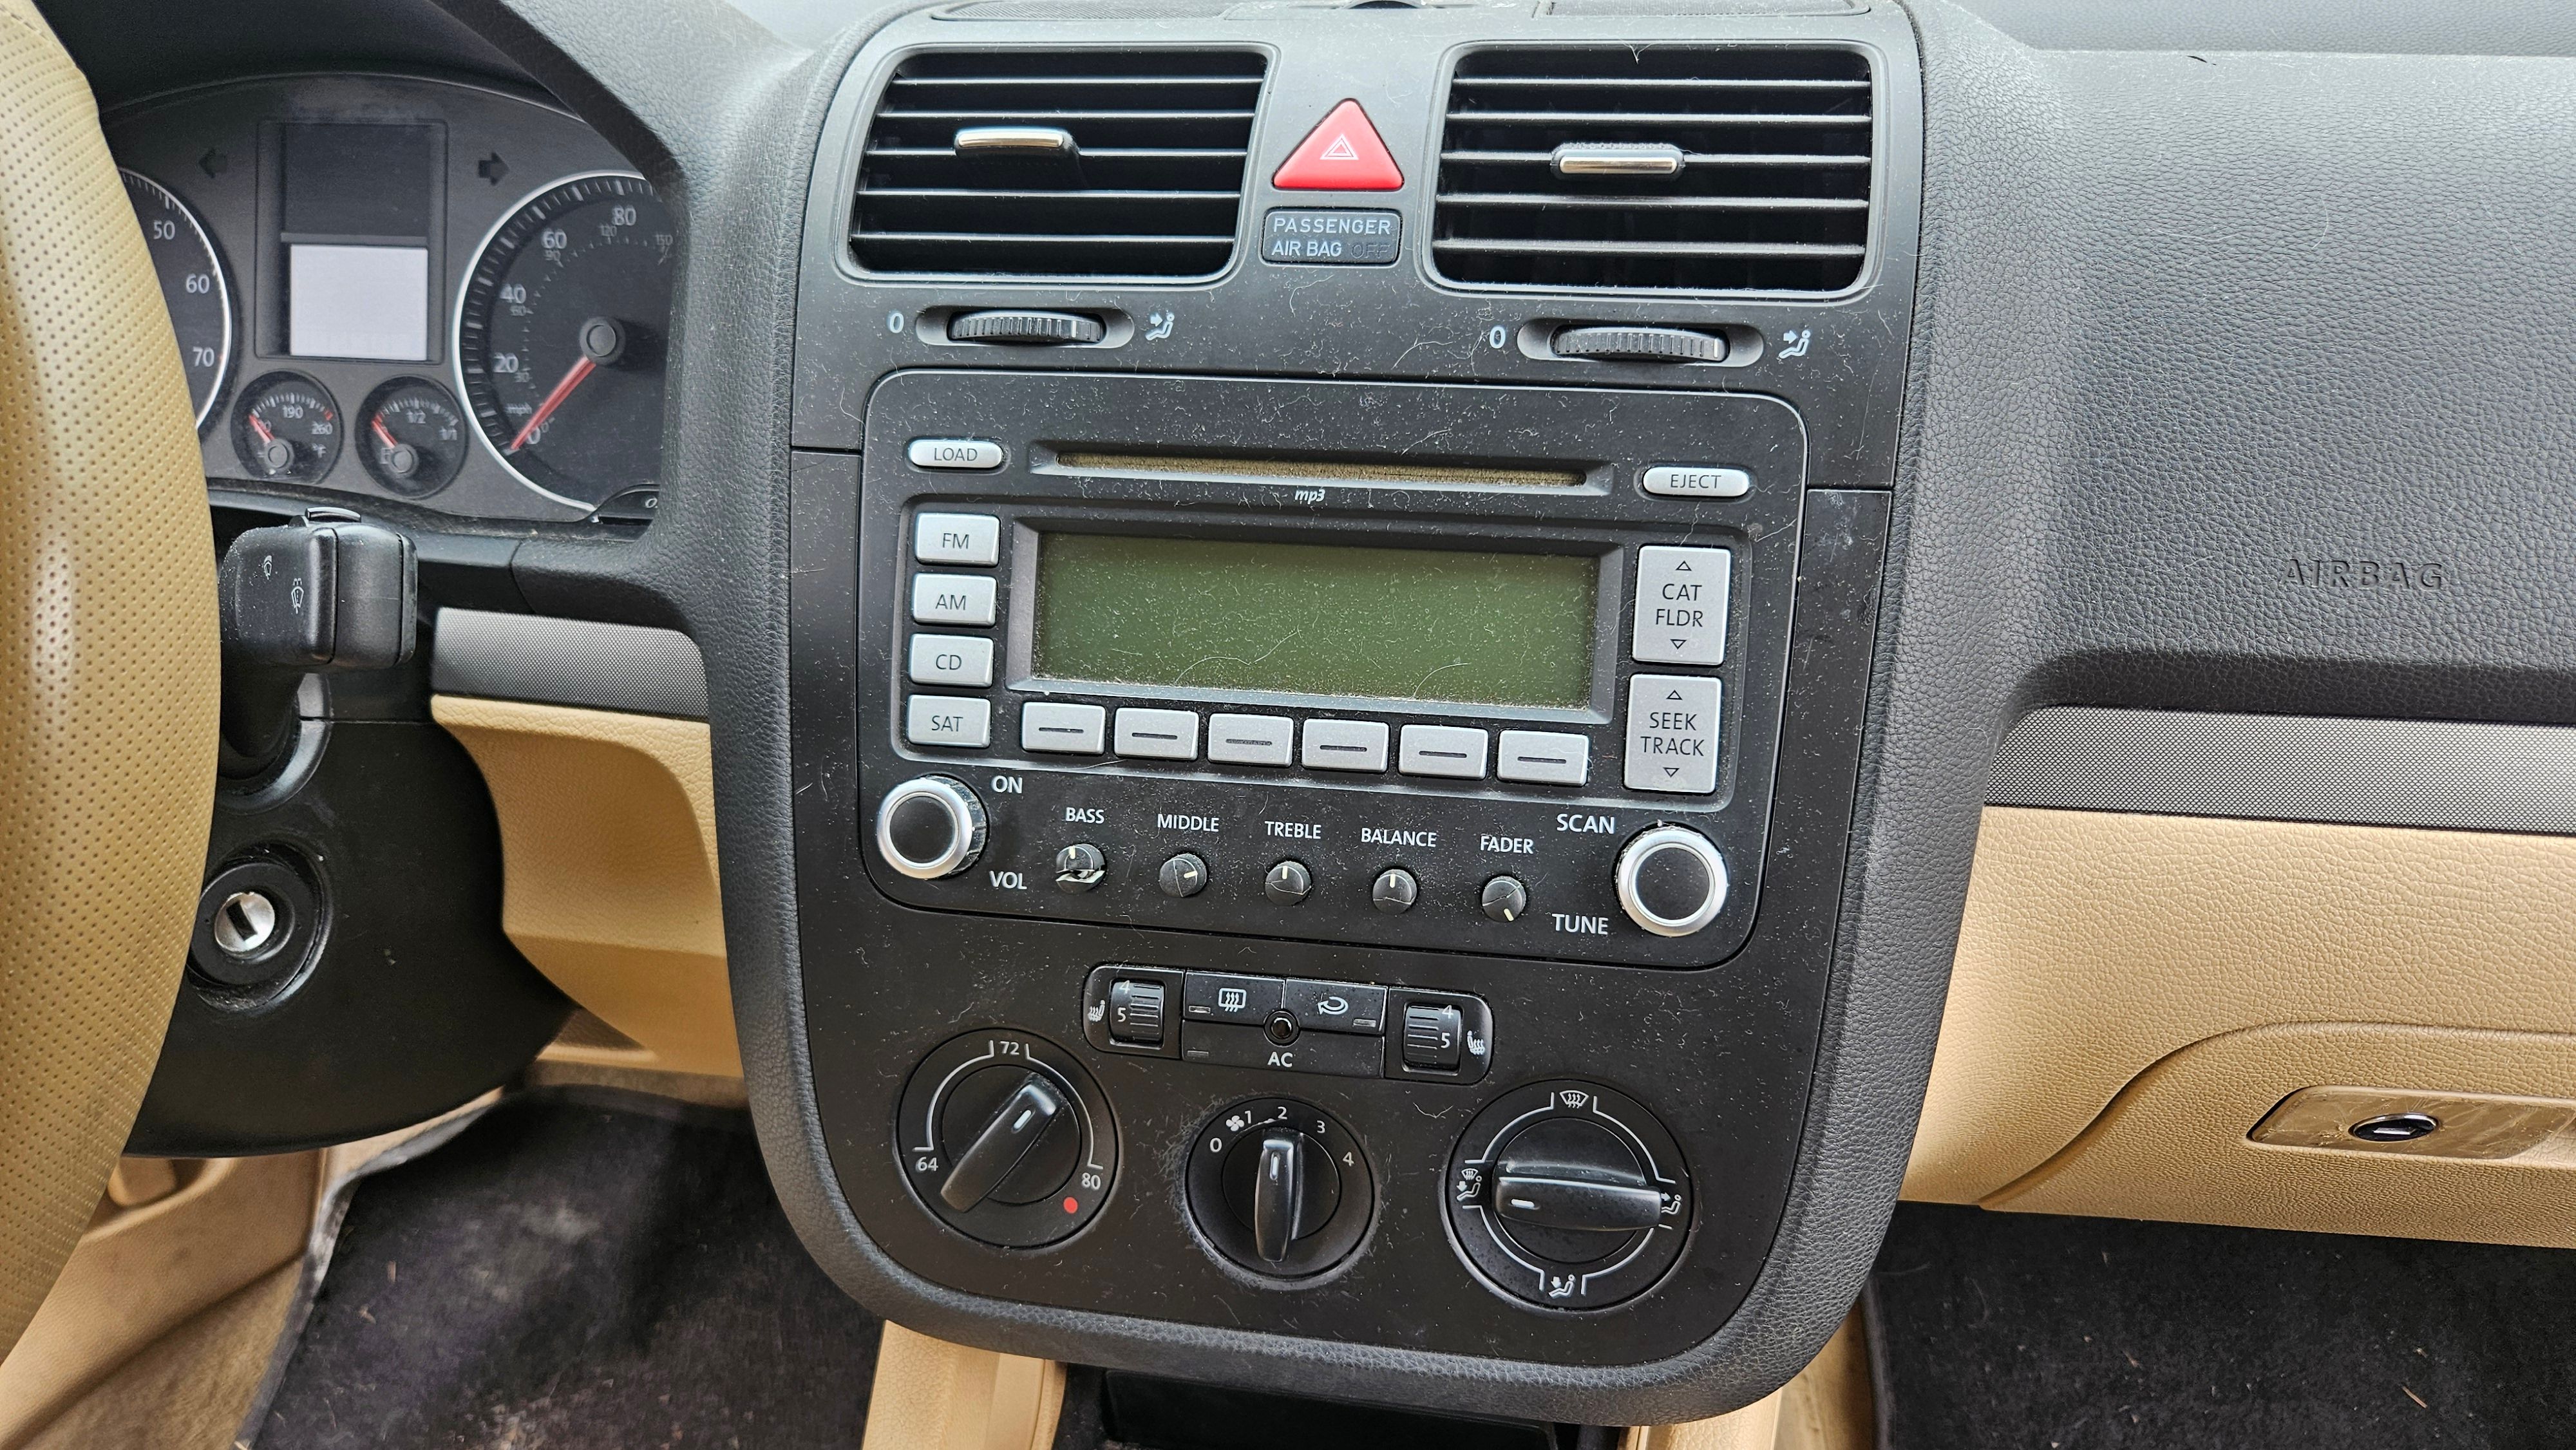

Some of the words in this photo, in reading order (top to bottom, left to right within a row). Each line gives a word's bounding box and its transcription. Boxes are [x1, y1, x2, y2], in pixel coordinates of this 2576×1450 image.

[613, 205, 636, 225] 80
[153, 220, 175, 240] 50
[1273, 218, 1390, 235] PASSENGER
[542, 228, 567, 249] 60
[1272, 240, 1301, 257] AIR
[1307, 241, 1342, 258] BAG
[1350, 243, 1390, 259] OFF
[185, 274, 210, 294] 60
[500, 283, 526, 303] 40
[193, 346, 214, 367] 70
[493, 352, 519, 373] 20
[282, 404, 303, 419] 190
[312, 421, 333, 435] 260
[934, 447, 978, 462] LOAD
[1670, 474, 1721, 489] EJECT
[1294, 489, 1325, 504] mp3
[942, 532, 969, 549] FM
[2280, 559, 2443, 590] AIRBAG
[1662, 583, 1702, 601] CAT
[935, 594, 966, 610] AM
[1656, 608, 1703, 628] FLDR
[936, 654, 961, 670] CD
[931, 715, 963, 732] SAT
[1649, 712, 1697, 731] SEEK
[1640, 736, 1705, 757] TRACK
[992, 775, 1023, 793] ON
[1066, 807, 1104, 824] BASS
[1157, 813, 1219, 832] MIDDLE
[1557, 813, 1615, 834] SCAN
[1264, 820, 1321, 840] TREBLE
[1361, 827, 1437, 848] BALANCE
[1480, 836, 1534, 854] FADER
[990, 871, 1027, 890] VOL
[1552, 913, 1609, 935] TUNE
[1119, 980, 1130, 994] 4
[1117, 1007, 1126, 1022] 5
[1442, 1005, 1454, 1019] 4
[999, 1040, 1020, 1055] 72
[1441, 1032, 1450, 1048] 5
[1267, 1051, 1293, 1068] AC
[1245, 1110, 1252, 1124] 1
[1277, 1106, 1287, 1120] 2
[1317, 1120, 1325, 1133] 3
[1209, 1138, 1222, 1153] 0
[916, 1156, 938, 1172] 64
[1343, 1151, 1354, 1167] 4
[1081, 1172, 1101, 1190] 80
